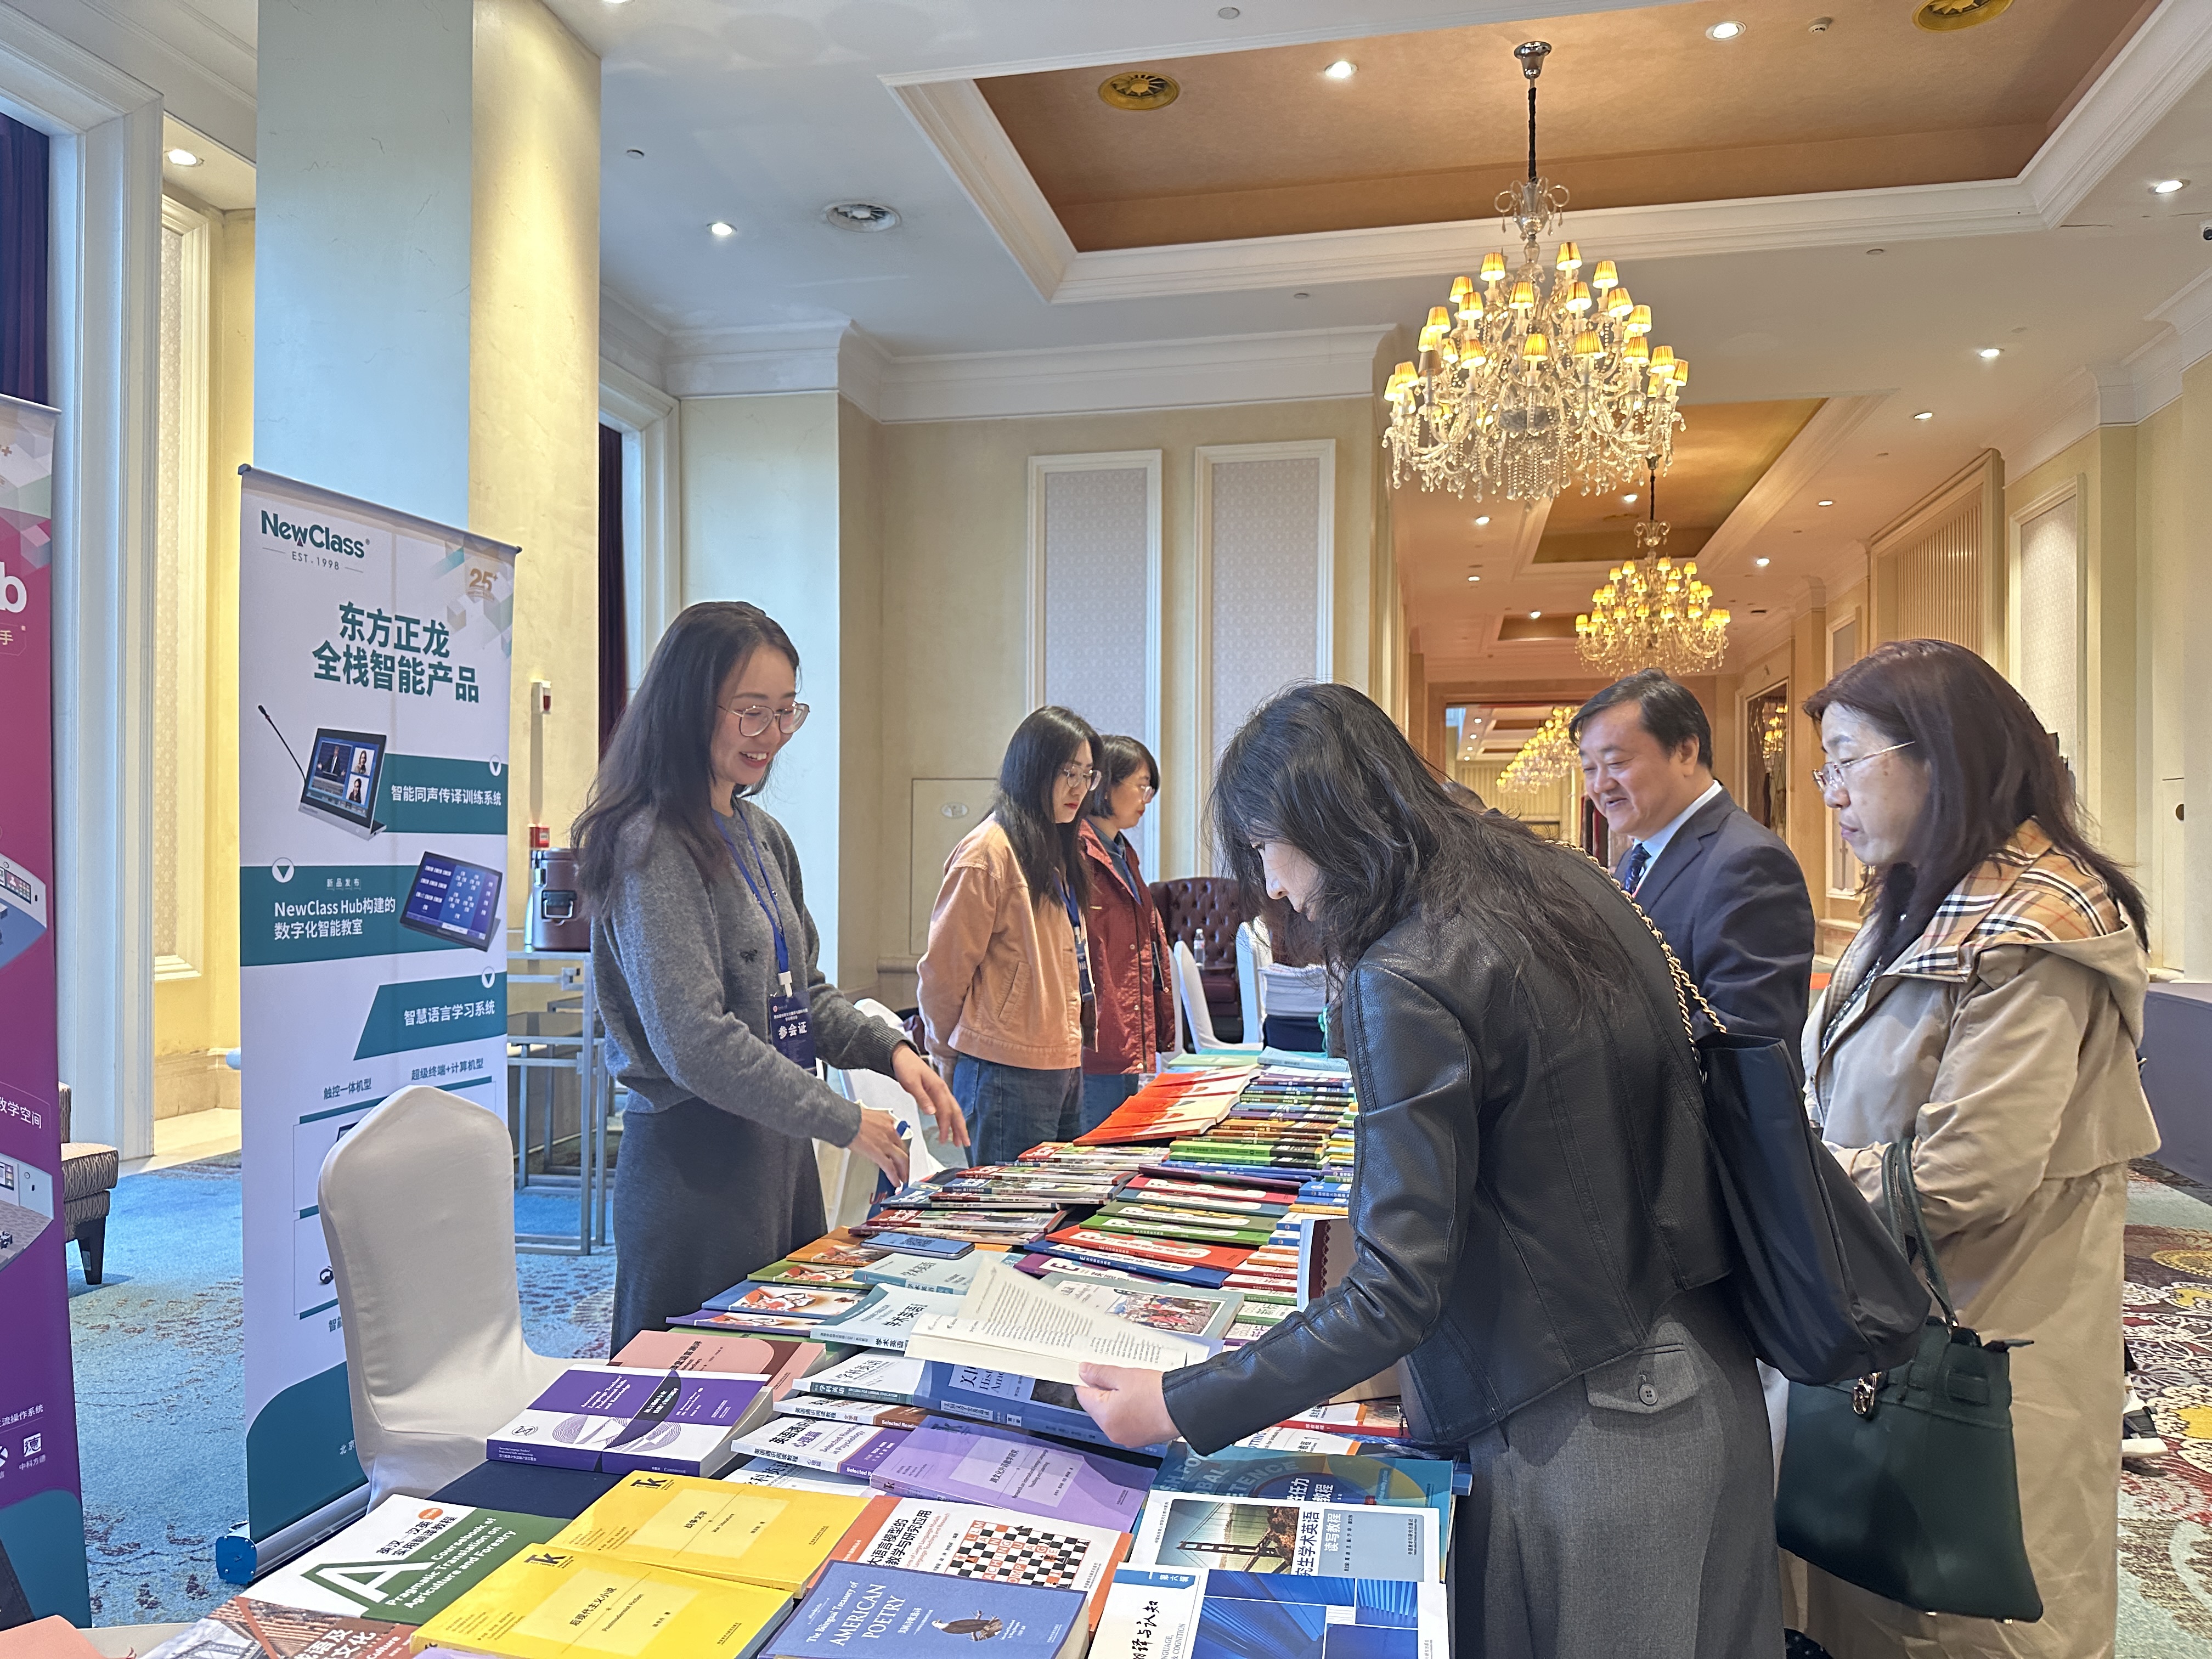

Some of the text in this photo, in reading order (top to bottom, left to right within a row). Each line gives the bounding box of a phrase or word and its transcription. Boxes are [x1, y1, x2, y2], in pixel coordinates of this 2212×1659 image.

[261, 510, 365, 558] NewClass
[339, 601, 450, 658] 东方正龙
[312, 641, 479, 703] 全栈智能产品
[391, 785, 502, 806] 智能同声传译训练系统
[275, 900, 338, 917] NewClass
[274, 918, 363, 940] 数字化智能教室
[404, 1000, 495, 1026] 智慧语言学习系统
[778, 1021, 807, 1040] 参会证
[411, 1058, 484, 1081] 超级终端+计算机型
[323, 1077, 372, 1100] 触控一体机型
[900, 1261, 937, 1277] 学术英语
[881, 1305, 925, 1327] 学术英语
[875, 1338, 904, 1349] 学术英语
[0, 1403, 43, 1427] 流操作系统
[339, 1439, 355, 1455] 北京
[793, 1430, 823, 1448] 心理篇
[819, 1437, 843, 1453] Selected
[837, 1430, 866, 1451] Psychology
[754, 1447, 798, 1463] 英语通识阅读教程
[989, 1448, 1019, 1483] 跨文化外语教学研究
[846, 1467, 868, 1475] Selected
[684, 1510, 708, 1528] 战争文学
[391, 1516, 459, 1556] 实用翻译教程
[431, 1524, 488, 1560] Coursebook
[484, 1517, 496, 1525] of
[867, 1519, 909, 1566] 大语言模型的
[883, 1509, 933, 1567] 教学与研究应用
[1324, 1513, 1341, 1552] 读写教程
[385, 1526, 503, 1606] Pragmatic Translation on
[404, 1530, 517, 1609] Agriculture and Forestry
[569, 1587, 617, 1627] 后现代主义小说
[806, 1630, 822, 1643] The
[815, 1611, 839, 1634] Bilingual
[831, 1588, 854, 1612] Treasury
[850, 1581, 859, 1589] of
[828, 1583, 887, 1647] AMERICAN
[861, 1595, 906, 1639] POETRY
[323, 1631, 377, 1659] 文化
[366, 1635, 401, 1659] Culture
[1172, 1623, 1186, 1655] COGNITION
